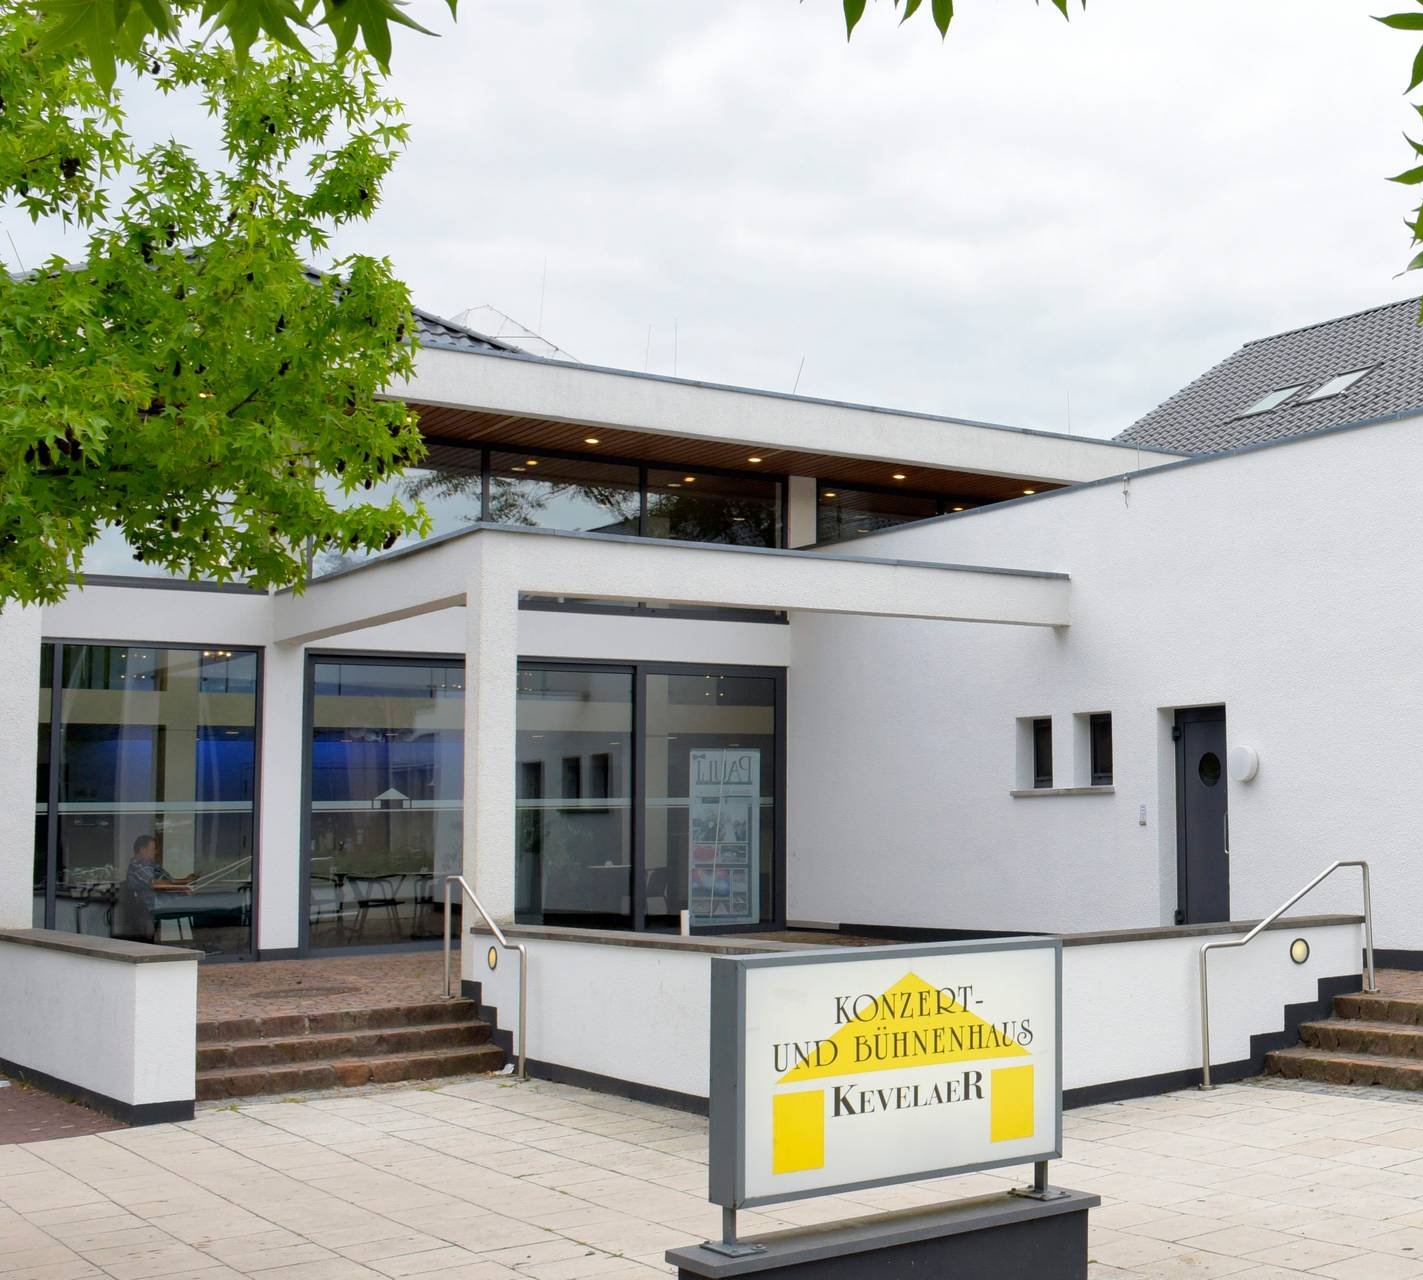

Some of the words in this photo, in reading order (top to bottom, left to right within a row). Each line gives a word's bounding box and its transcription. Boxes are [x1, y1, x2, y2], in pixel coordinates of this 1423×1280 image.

[834, 984, 984, 1025] KONZERT-
[773, 1038, 839, 1073] UND
[853, 1019, 1034, 1063] BÜHNENHAUS
[831, 1070, 986, 1118] KEVELAER
